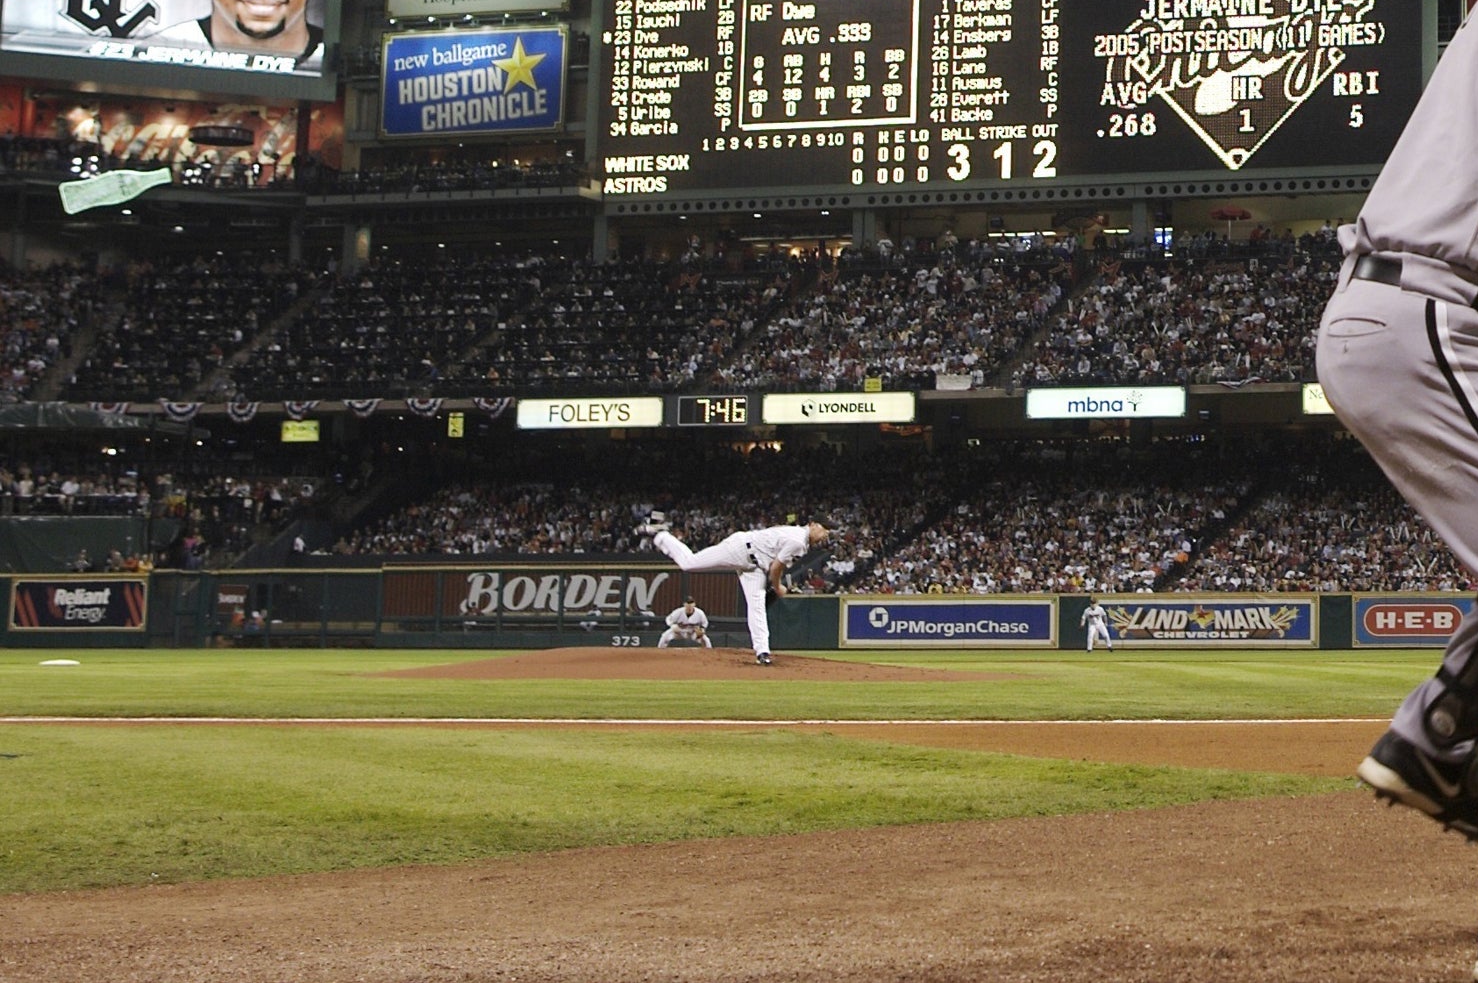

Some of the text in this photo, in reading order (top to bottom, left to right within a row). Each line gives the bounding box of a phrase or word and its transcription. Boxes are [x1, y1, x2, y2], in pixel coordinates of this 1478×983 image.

[615, 0, 632, 14] 22
[750, 4, 773, 21] RF
[942, 0, 949, 13] 1
[615, 16, 631, 29] 15
[717, 11, 735, 25] 2B
[934, 9, 1060, 29] 17 Berkman LF
[614, 31, 631, 44] 23
[717, 26, 735, 40] RF
[782, 26, 820, 46] AVG
[933, 24, 1059, 45] 14 Ensberg 3B
[1094, 32, 1140, 57] 2005
[1149, 28, 1263, 54] POSTSEASON
[1318, 22, 1386, 47] GAMES)
[394, 43, 507, 71] new ballgame
[614, 41, 734, 60] 14 Konerko 1B
[931, 40, 1059, 60] 26 Lamb 1B
[614, 56, 733, 75] 12 Pierzynski C
[932, 56, 1059, 76] 16 Lane RF
[399, 66, 502, 105] HOUSTON
[612, 72, 733, 90] 33 Rowand CF
[932, 77, 946, 91] 11
[1048, 72, 1058, 86] C
[1101, 71, 1380, 106] AVG HR RBI
[611, 87, 732, 106] 24 Crede 3B
[930, 87, 1058, 107] 28 Everett SS
[422, 89, 548, 131] CHRONICLE
[618, 103, 732, 121] 5 Uribe SS
[930, 104, 1057, 123] 41 Backe P
[610, 118, 731, 136] 34 Garcia P
[1096, 104, 1363, 137] .268 1 5
[702, 132, 844, 151] 1 2 3 4 5 6 7 8 9 10
[941, 123, 1059, 141] BALL STRIKE OUT
[604, 154, 690, 173] WHITE SOX
[947, 140, 1057, 181] 3 1 2
[603, 176, 668, 194] ASTROS
[549, 403, 631, 422] FOLEY'S
[697, 398, 747, 423] 7:46
[819, 402, 876, 414] LYONDELL
[1068, 396, 1123, 413] mbna
[54, 588, 110, 606] Reliant
[460, 572, 669, 614] BORDEN
[65, 605, 106, 623] Energy
[1127, 606, 1280, 630] LAND MARK
[887, 620, 1029, 636] JPMorganChase
[1152, 630, 1250, 639] CHEVROLET
[611, 636, 640, 646] 373
